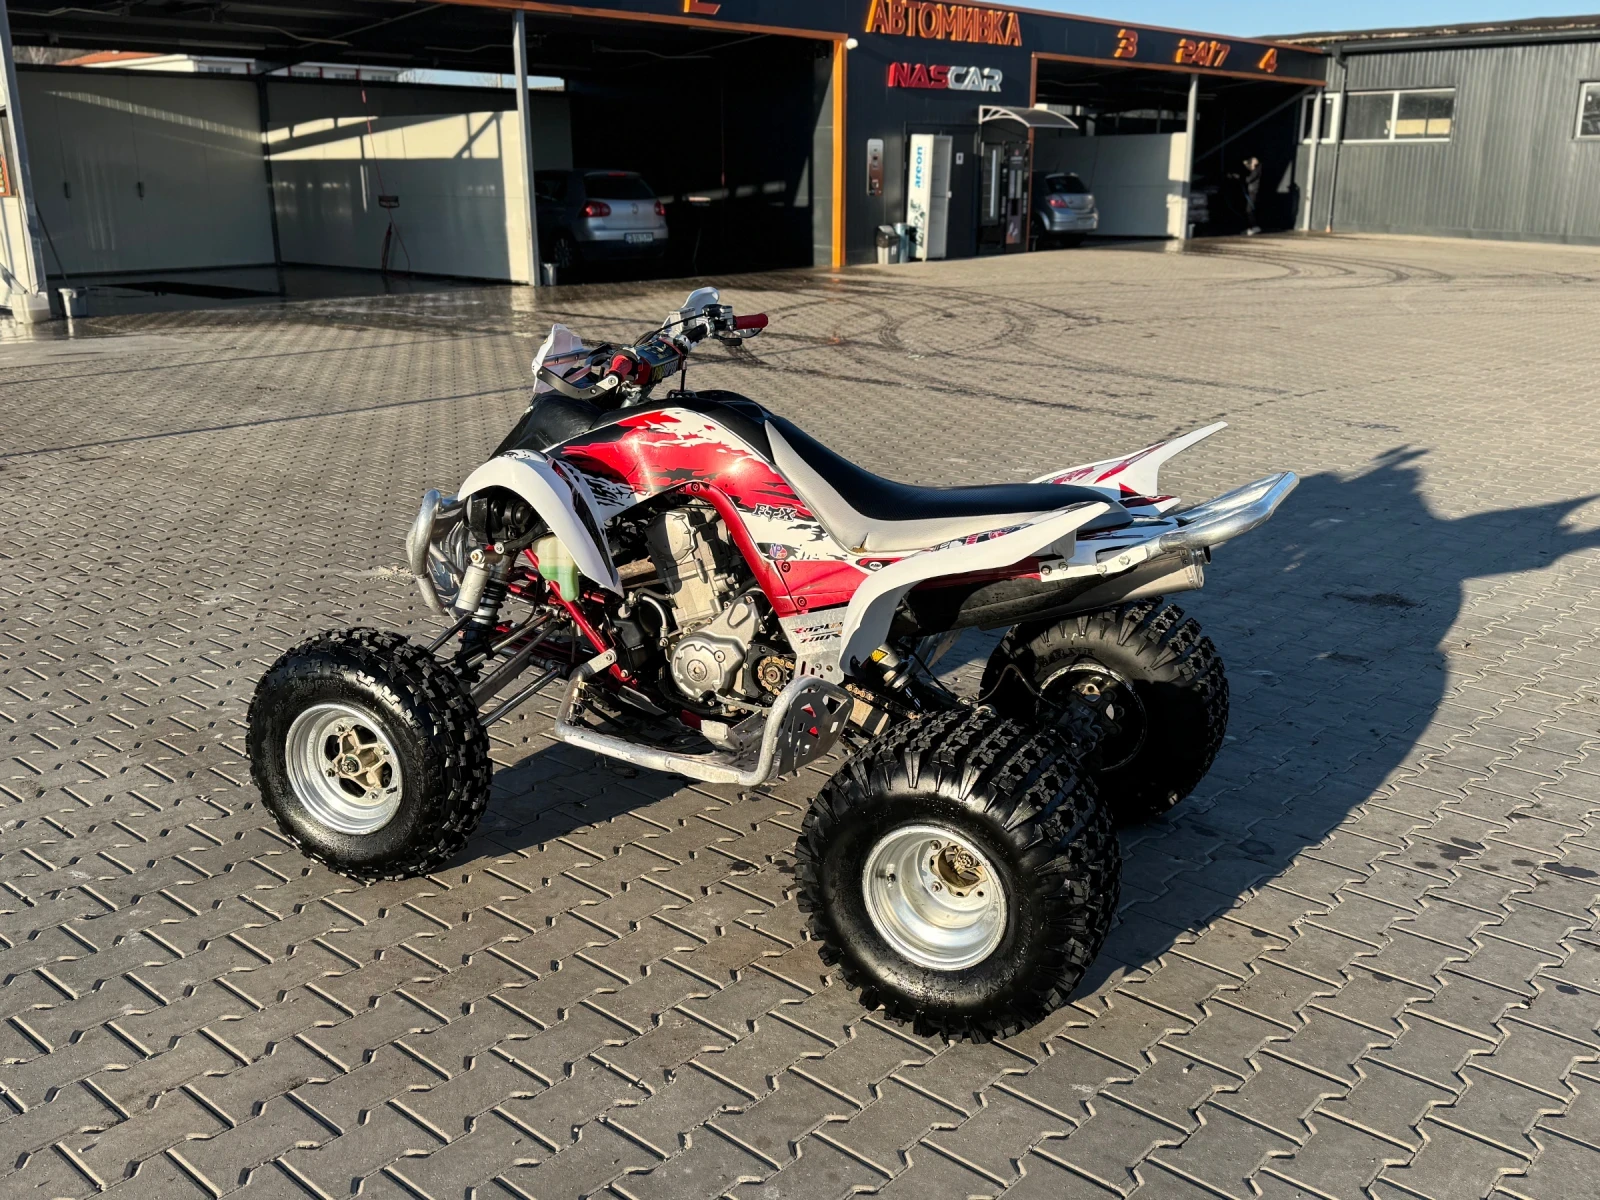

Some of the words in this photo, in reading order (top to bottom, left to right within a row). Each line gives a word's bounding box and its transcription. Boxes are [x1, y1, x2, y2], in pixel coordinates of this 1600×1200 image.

[865, 0, 1022, 46] АВТОМИВКА
[1114, 28, 1138, 58] 3
[1175, 38, 1230, 67] 24/7
[1259, 48, 1278, 73] 4
[888, 62, 1003, 92] NASCAR
[914, 146, 923, 188] areon
